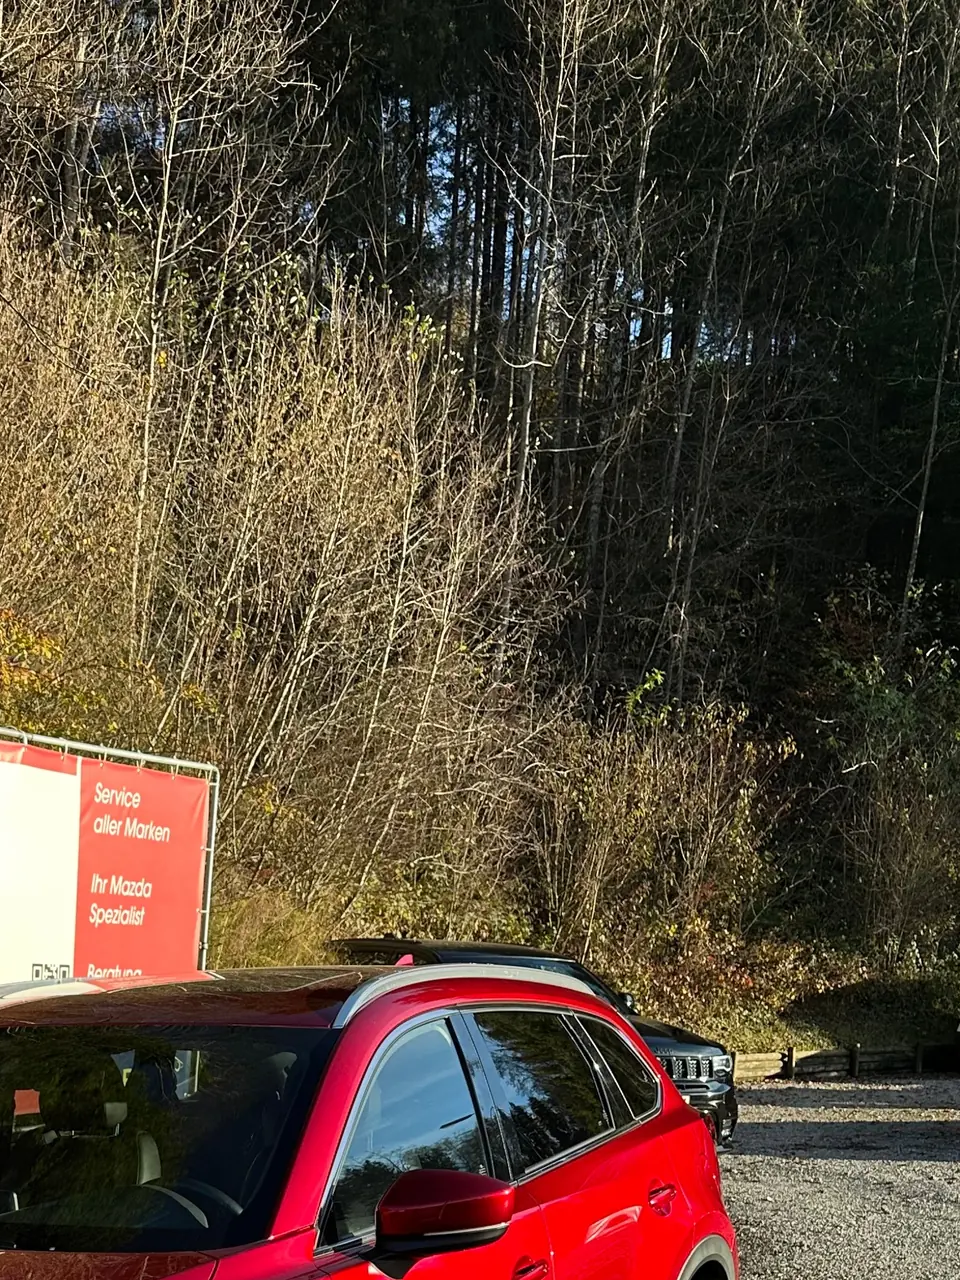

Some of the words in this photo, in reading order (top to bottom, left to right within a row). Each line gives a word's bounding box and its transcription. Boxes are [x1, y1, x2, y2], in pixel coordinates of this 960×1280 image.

[94, 782, 141, 808] Service
[93, 814, 122, 836] aller
[124, 817, 171, 842] Marken
[90, 873, 108, 894] Ihr
[109, 875, 152, 898] Mazda
[89, 902, 145, 928] Spezialist
